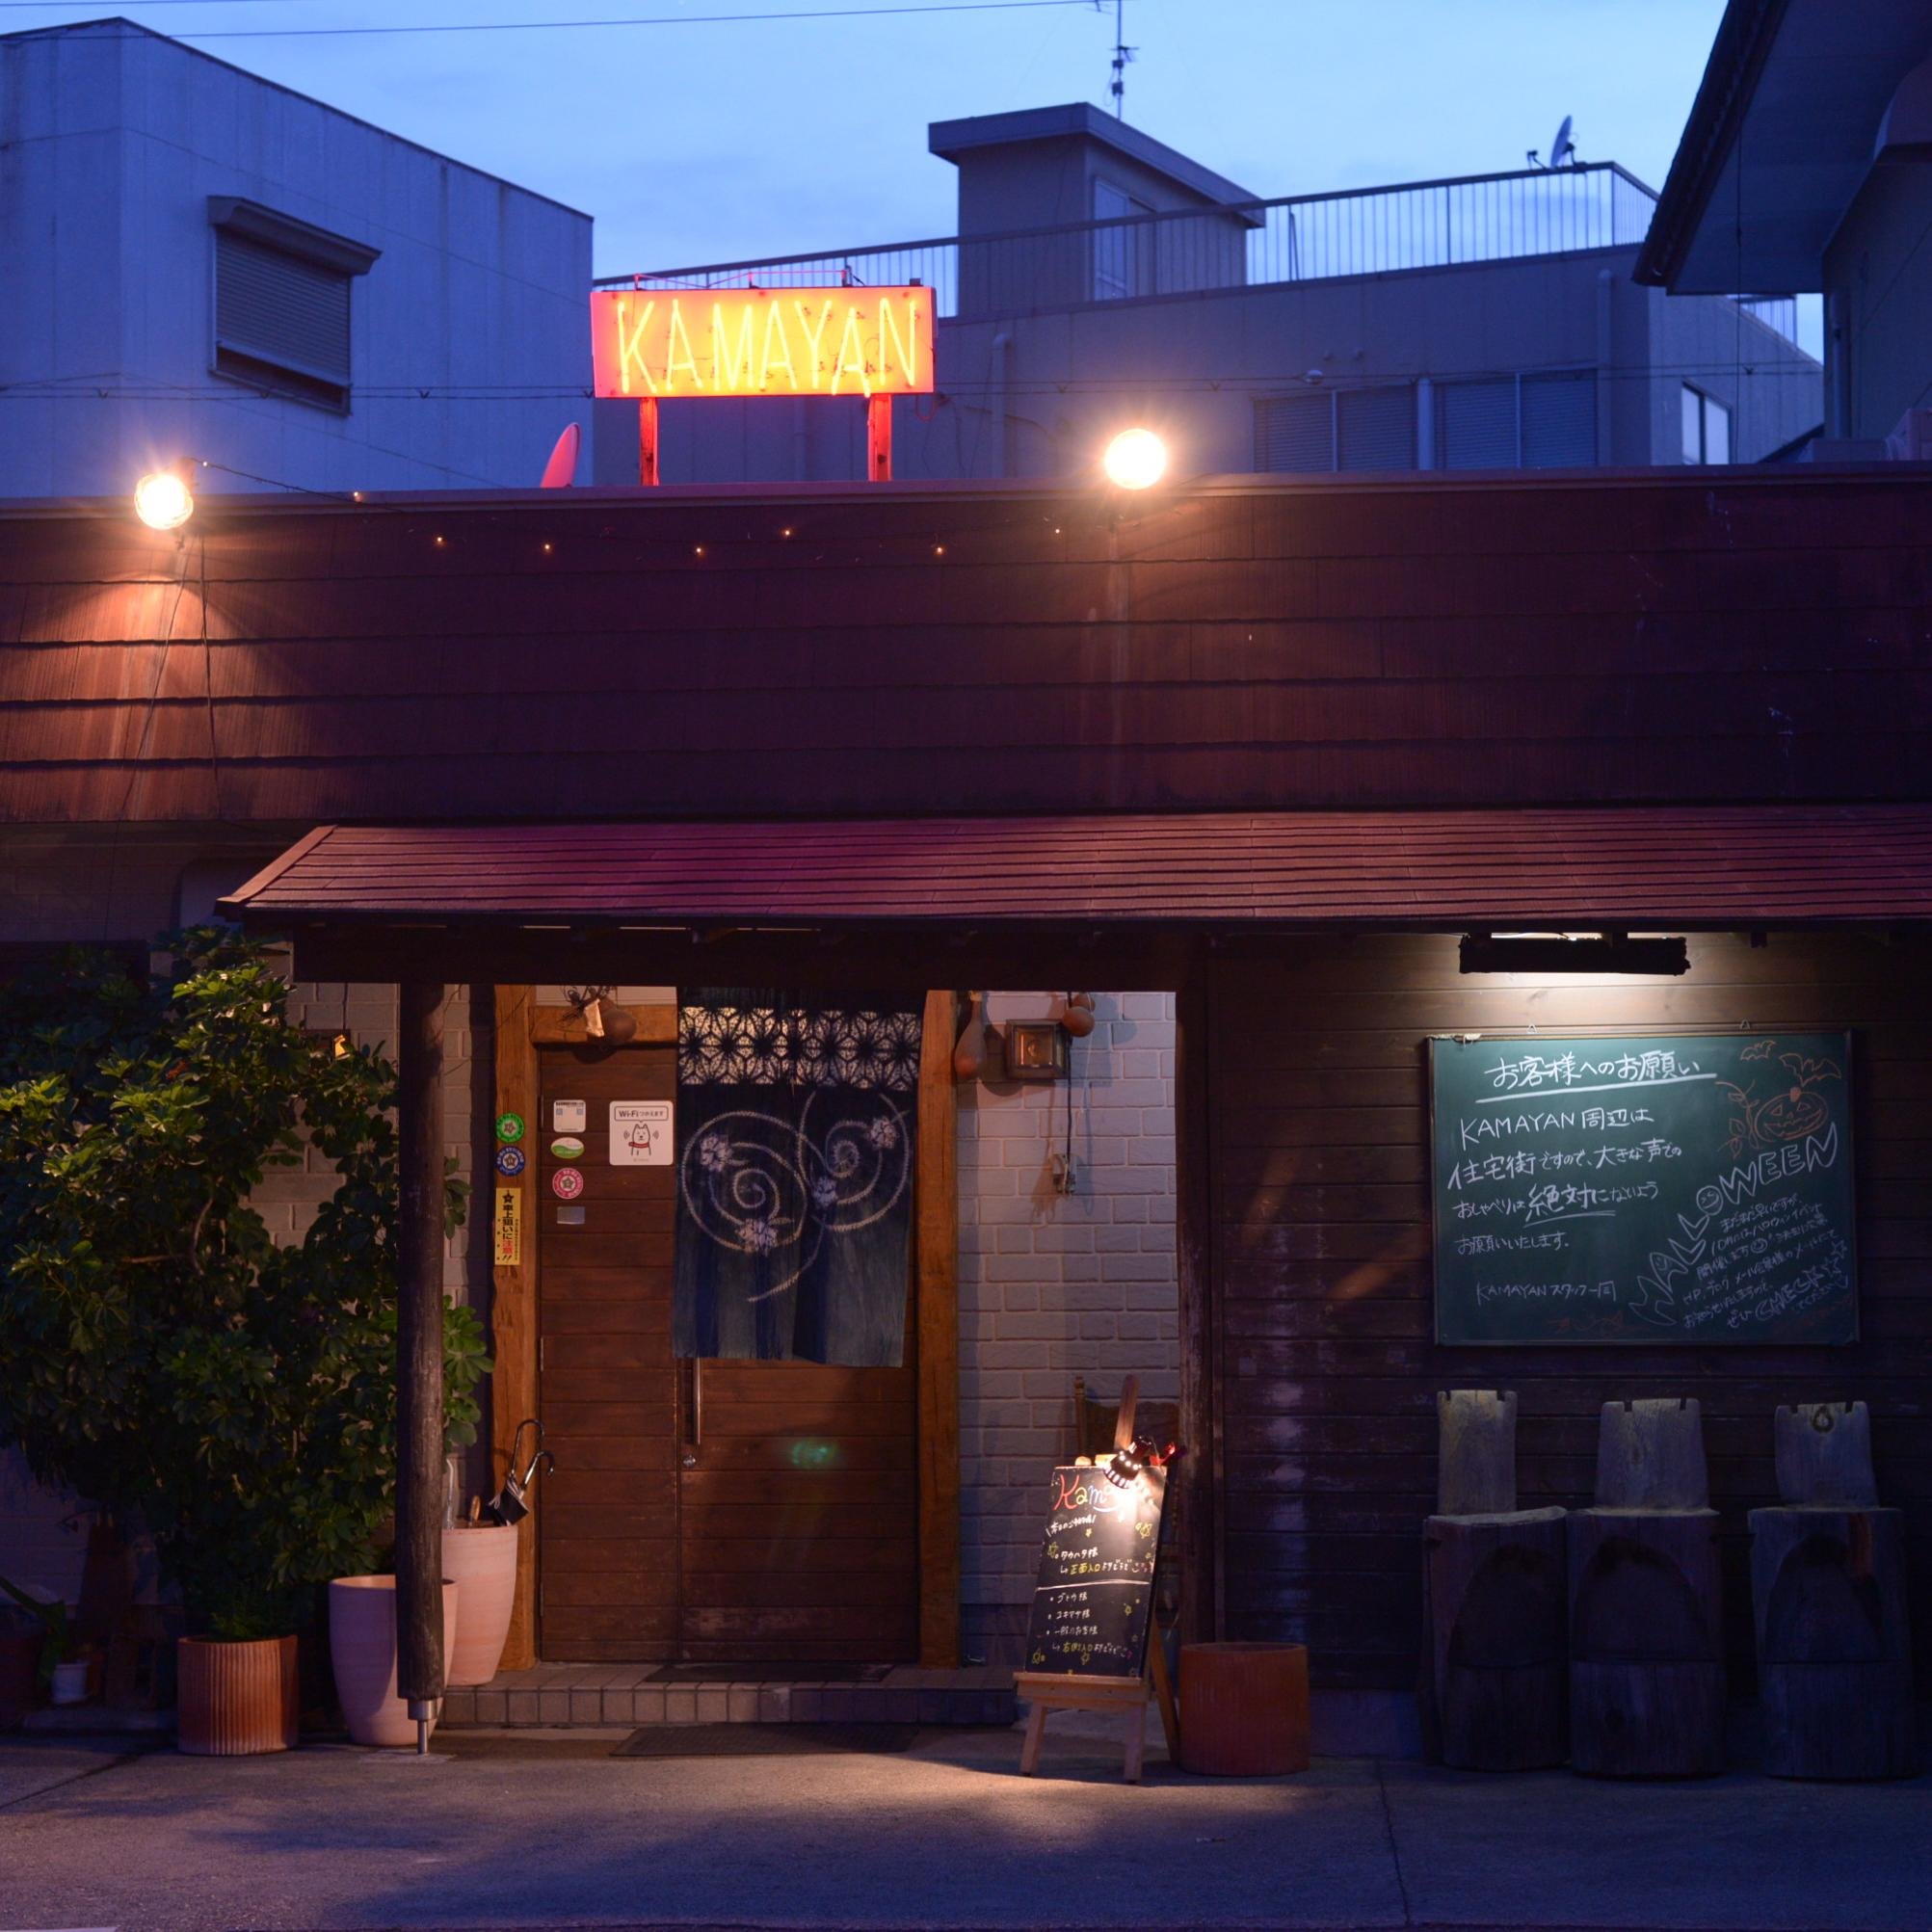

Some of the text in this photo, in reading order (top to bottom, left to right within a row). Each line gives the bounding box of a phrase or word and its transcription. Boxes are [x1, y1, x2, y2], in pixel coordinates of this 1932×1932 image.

[618, 298, 916, 398] KAMAYAN
[1484, 1050, 1700, 1090] お客様へのお願い
